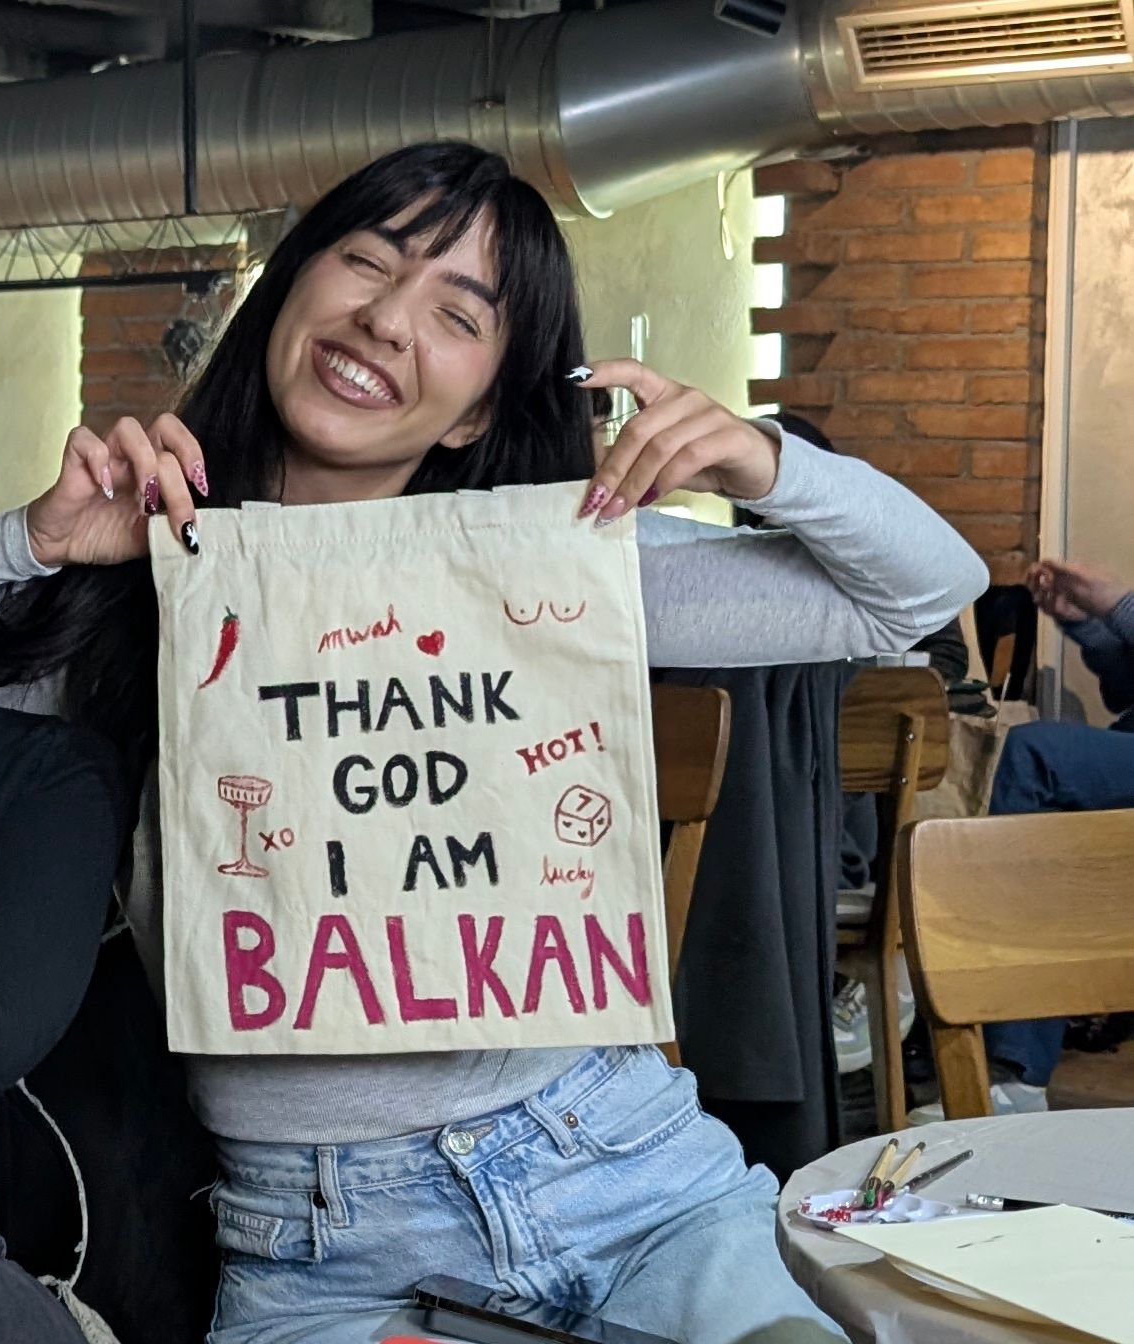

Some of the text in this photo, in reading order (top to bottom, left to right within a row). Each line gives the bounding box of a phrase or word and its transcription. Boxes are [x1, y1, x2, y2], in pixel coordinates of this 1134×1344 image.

[318, 603, 403, 654] mwah
[257, 670, 523, 742] THANK
[515, 721, 606, 776] HOT!
[332, 750, 469, 815] GOD
[576, 793, 593, 812] 7
[327, 831, 500, 898] I AM
[540, 854, 596, 900] lucky
[222, 909, 654, 1032] BALKAN
